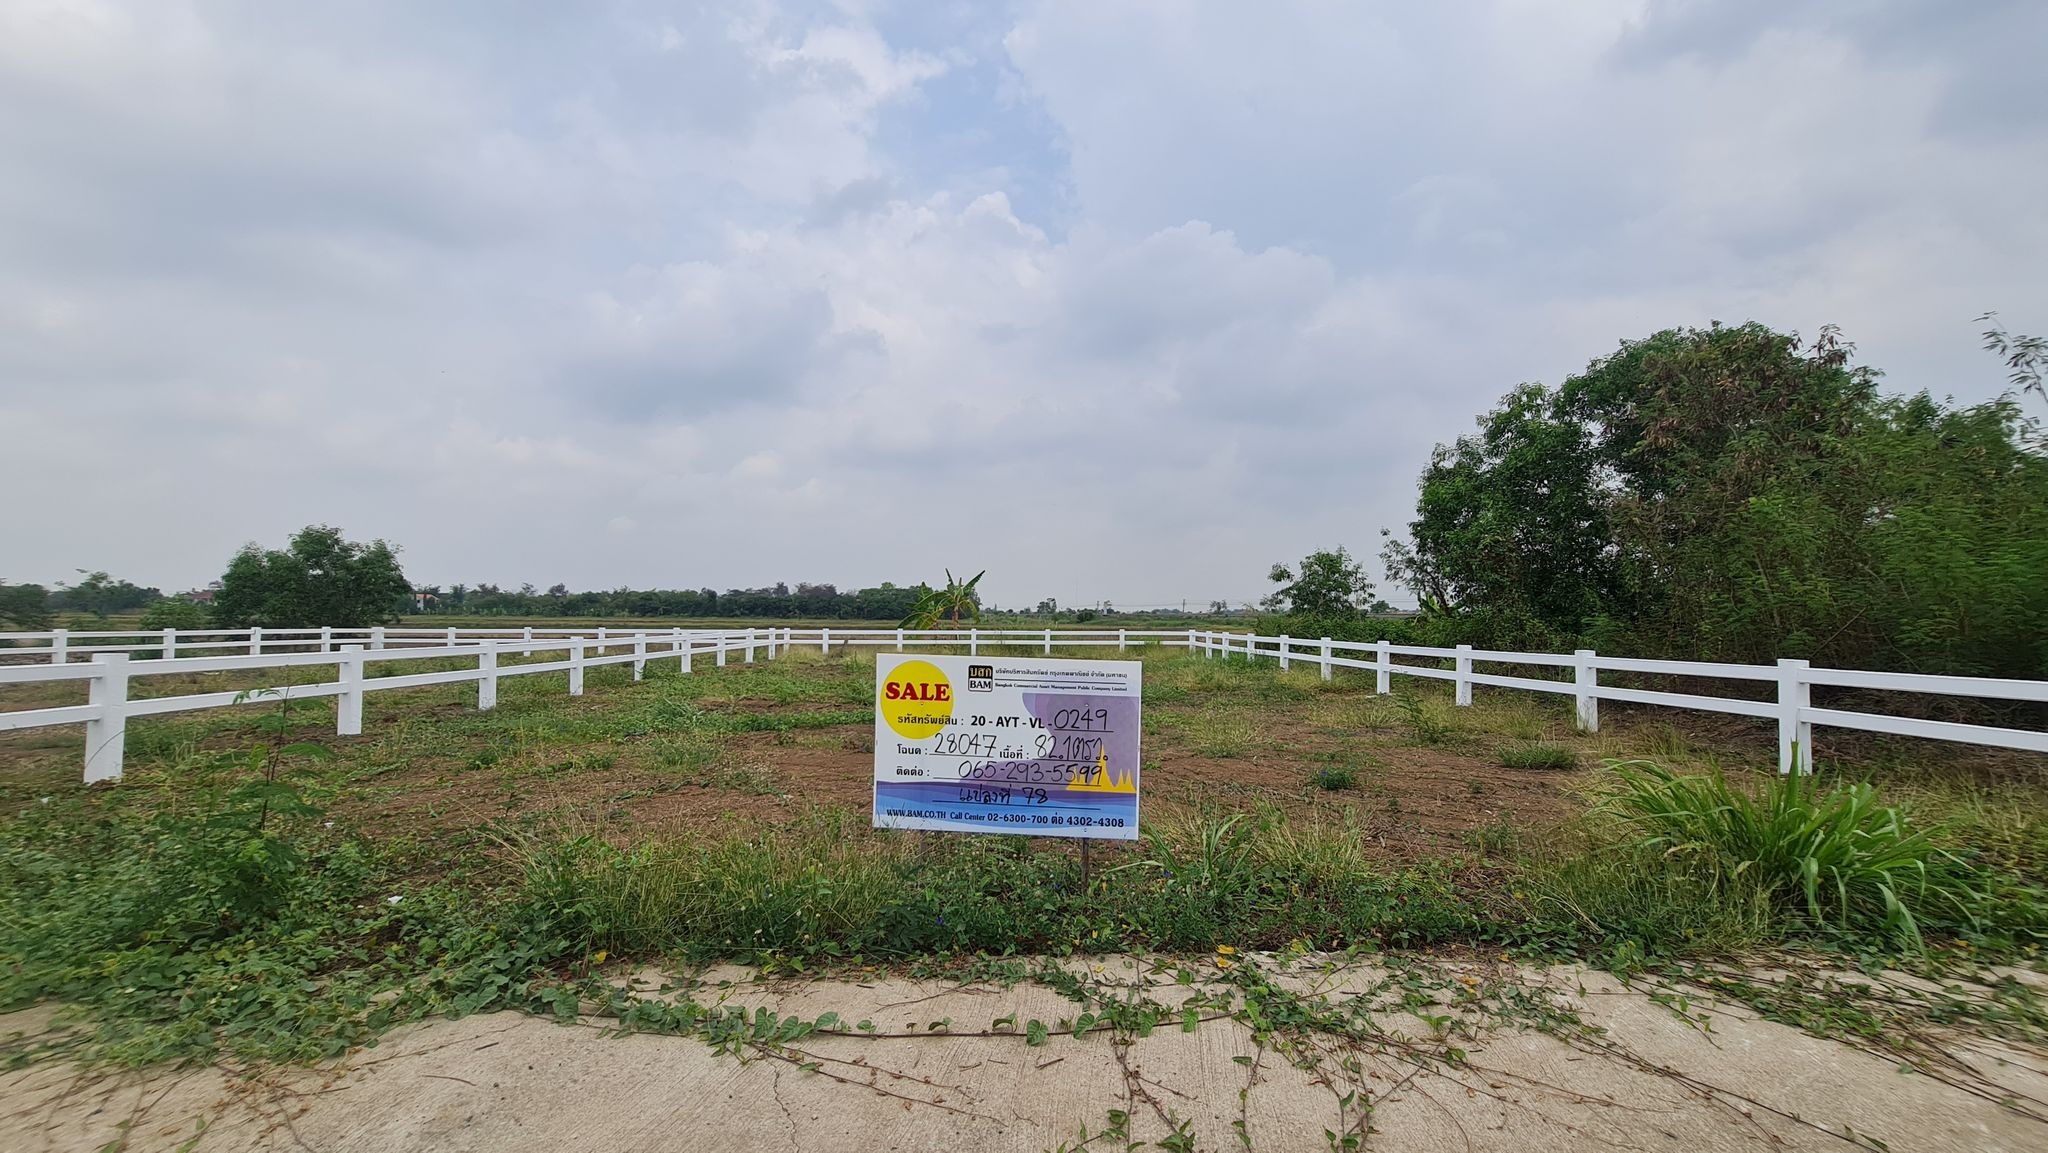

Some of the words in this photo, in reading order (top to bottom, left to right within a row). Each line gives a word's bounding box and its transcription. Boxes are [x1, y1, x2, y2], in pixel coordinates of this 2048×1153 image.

[970, 667, 992, 677] บสก
[885, 682, 951, 702] SALE
[970, 679, 992, 689] BAM
[897, 713, 958, 726] รหัสทรัพย์สิน
[1054, 708, 1108, 730] 0249
[934, 732, 997, 758] 28047
[896, 765, 923, 777] ติดต่อ
[958, 760, 1103, 784] 065-293-5599
[1022, 787, 1049, 804] 78
[887, 809, 946, 819] WWW.BAM.CO.TH
[950, 811, 963, 820] Call
[964, 812, 985, 821] Center
[987, 813, 1048, 824] 02-6300-700
[1051, 812, 1064, 825] ต่อ
[1066, 816, 1124, 828] 4302-4308
